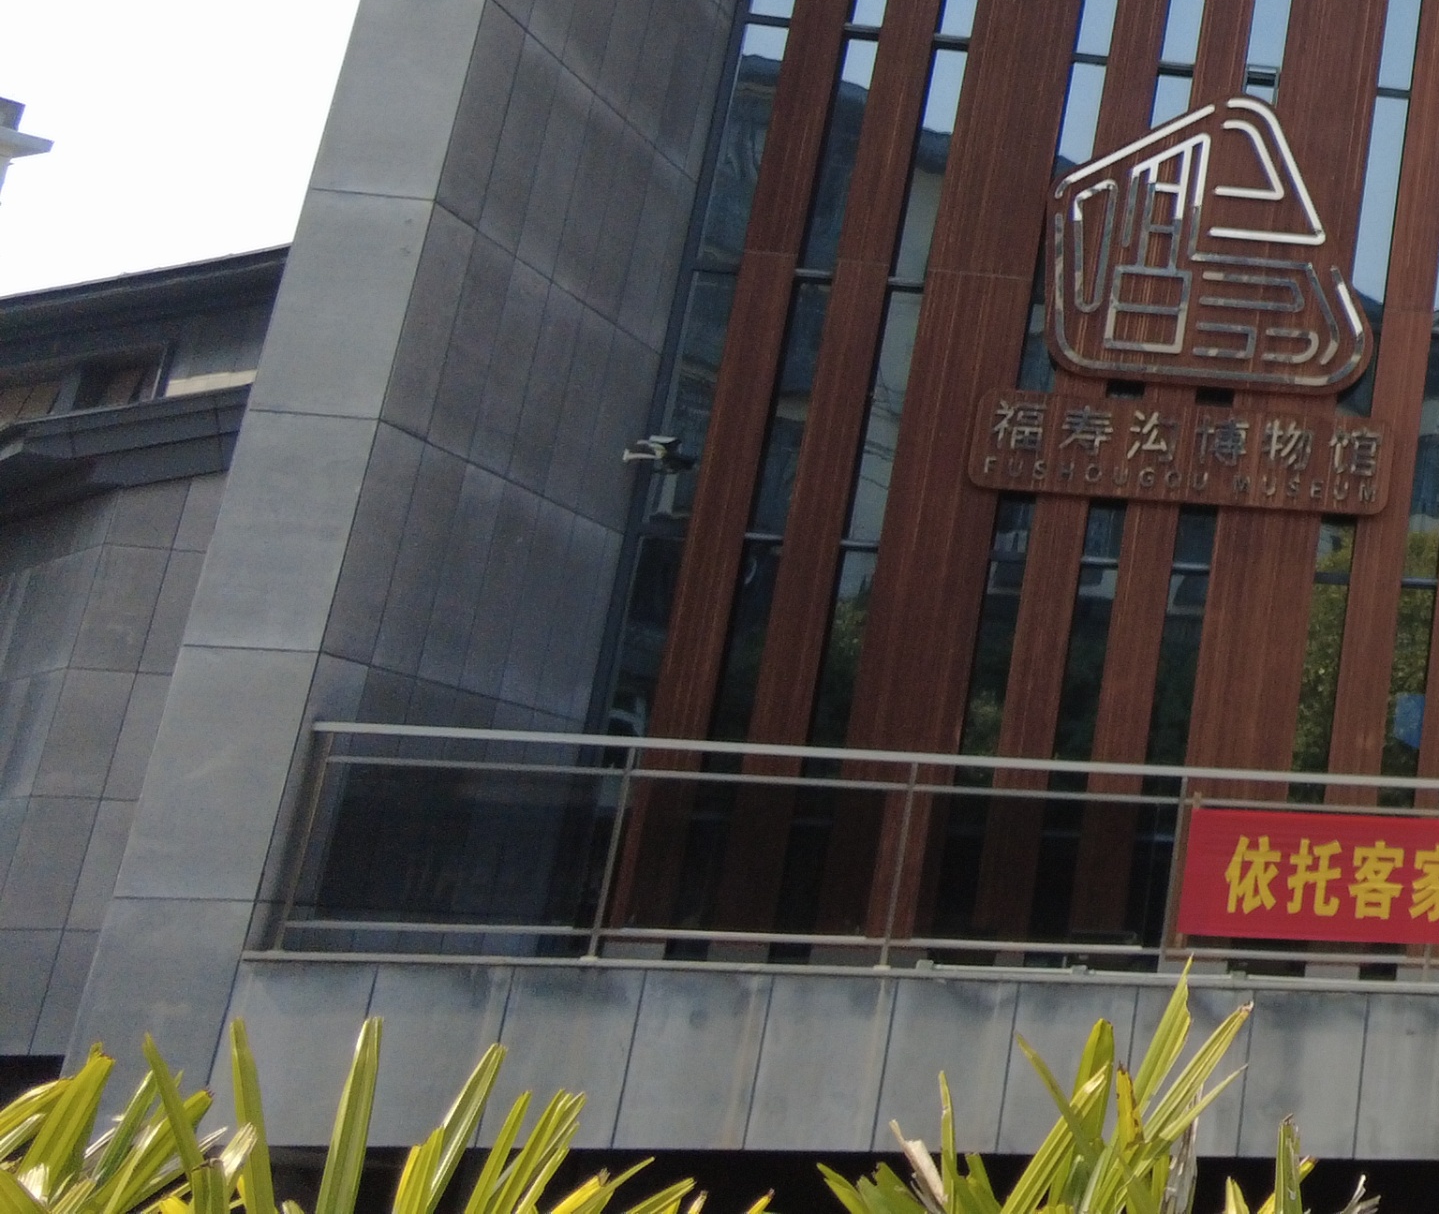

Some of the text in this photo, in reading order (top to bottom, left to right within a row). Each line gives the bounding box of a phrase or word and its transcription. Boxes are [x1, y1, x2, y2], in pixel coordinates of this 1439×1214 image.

[992, 399, 1382, 478] 福寿沟博物馆
[983, 456, 1379, 503] FUSHOUGOU MUSEUM
